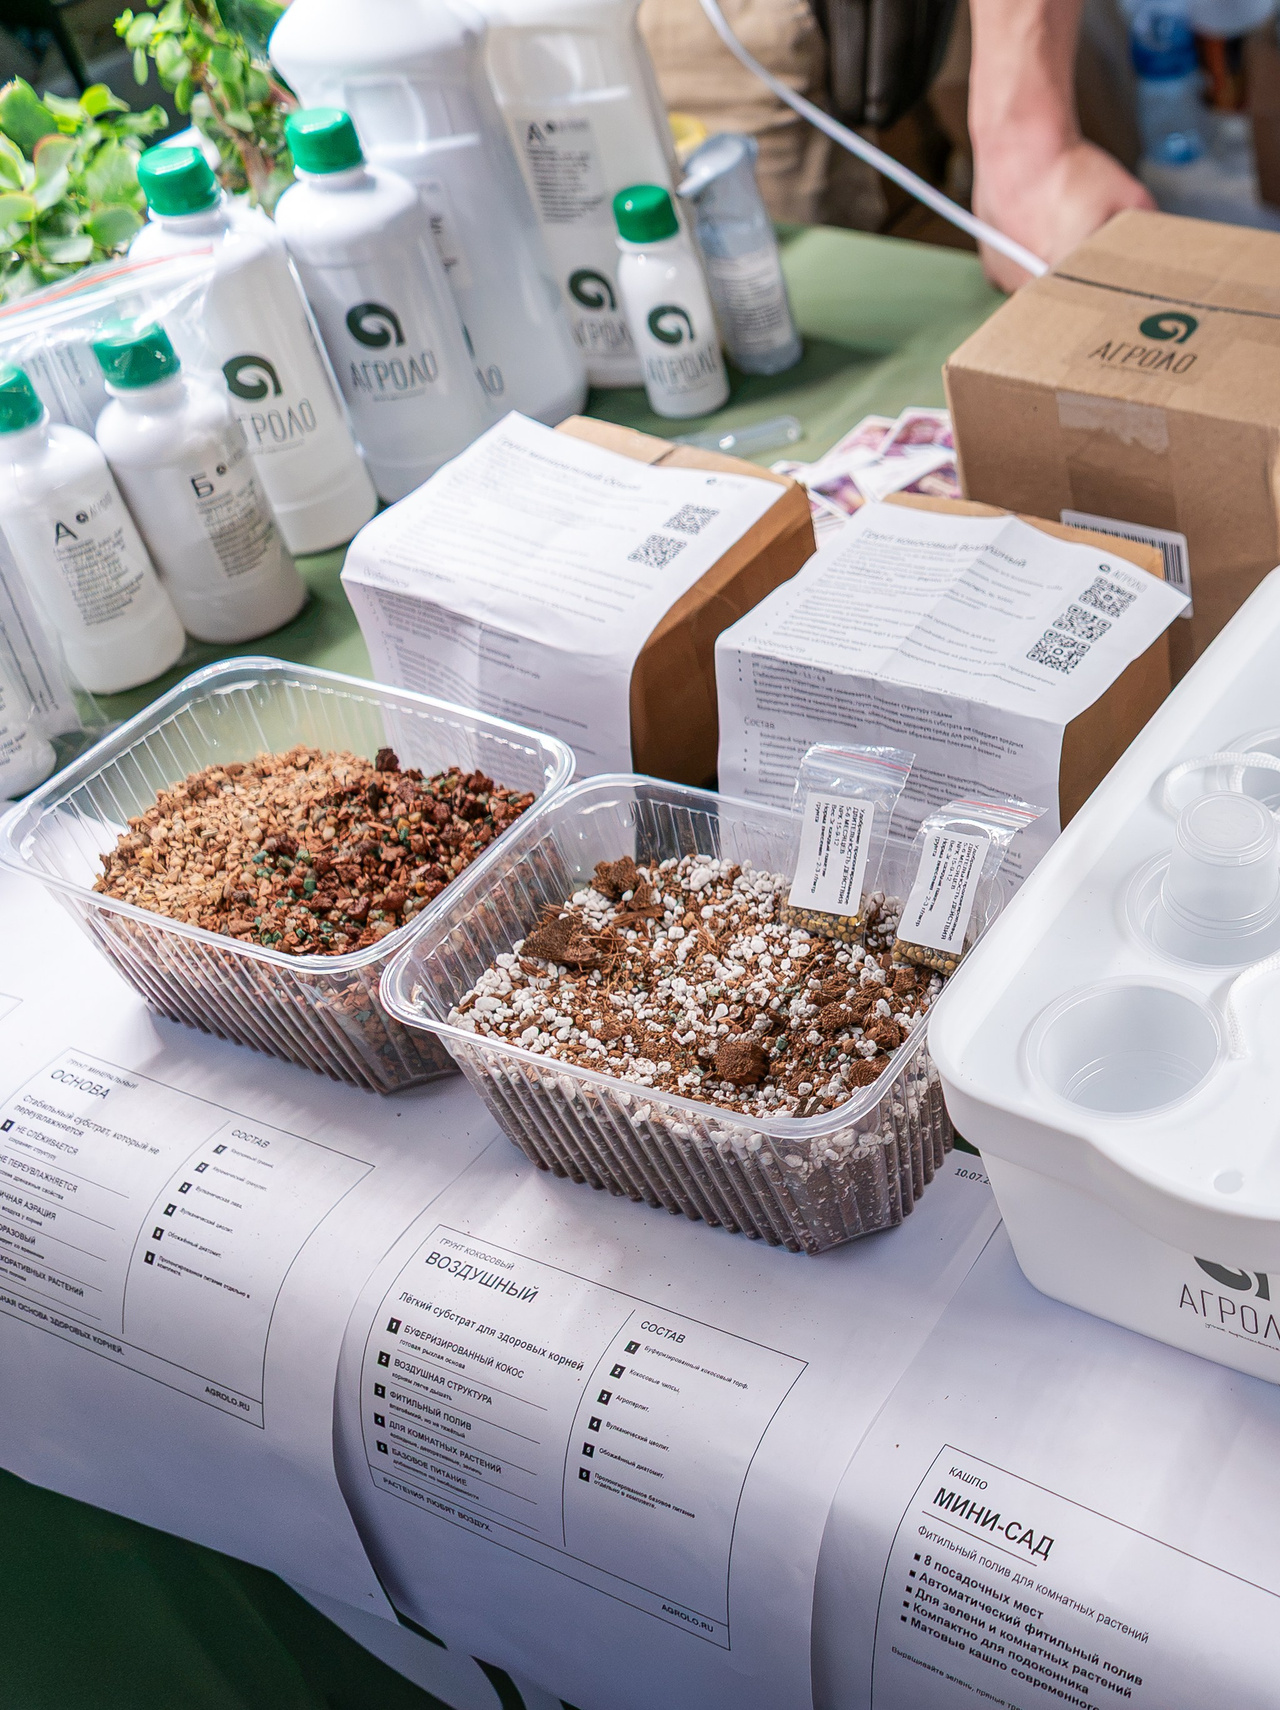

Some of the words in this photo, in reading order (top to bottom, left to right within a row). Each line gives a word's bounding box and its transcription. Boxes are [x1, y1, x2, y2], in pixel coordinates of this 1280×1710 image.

[350, 350, 439, 392] АГРОЛО
[1088, 341, 1198, 374] АГРОЛО
[237, 399, 317, 442] ГРОЛО
[190, 472, 214, 499] Б
[55, 520, 78, 546] А
[51, 1069, 111, 1099] ОСНОВА
[14, 1104, 85, 1138] переувлажняется
[23, 1094, 75, 1121] Стабильный
[73, 1115, 111, 1138] субстрат,
[112, 1131, 149, 1151] который
[149, 1146, 160, 1155] не
[16, 1125, 25, 1135] НЕ
[26, 1128, 79, 1156] СЛЁЖИВАЕТСЯ
[231, 1129, 271, 1149] СОСТАВ
[8, 1158, 78, 1193] ПЕРЕУВЛАЖНЯЕТСЯ
[954, 1168, 992, 1186] 10.07.2
[23, 1199, 57, 1221] АЭРАЦИЯ
[439, 1237, 465, 1253] ГРУНТ
[464, 1246, 515, 1271] КОКОСОВЫЙ
[48, 1274, 84, 1297] РАСТЕНИЙ
[425, 1251, 539, 1304] ВОЗДУШНЫЙ
[18, 1302, 49, 1321] ОСНОВА
[50, 1316, 92, 1340] ЗДОРОВЫХ
[399, 1291, 433, 1312] Лёгкий
[433, 1306, 477, 1329] субстрат
[476, 1324, 497, 1338] для
[497, 1331, 548, 1357] здоровых
[548, 1351, 585, 1372] корней
[640, 1320, 686, 1344] СОСТАВ
[399, 1339, 422, 1352] готовая
[422, 1348, 445, 1361] рыхлая
[445, 1357, 466, 1370] основа
[404, 1325, 494, 1368] БУФЕРИЗИРОВАННЫЙ
[495, 1361, 525, 1379] КОКОС
[644, 1345, 700, 1371] Буферизированный
[700, 1366, 733, 1383] кокосовый
[732, 1378, 749, 1390] торф.
[394, 1358, 446, 1386] ВОЗДУШНАЯ
[447, 1380, 493, 1405] СТРУКТУРА
[629, 1369, 660, 1386] Кокосовые
[205, 1386, 250, 1412] AGROLO.RU
[390, 1391, 442, 1418] ФИТИЛЬНЫЙ
[443, 1412, 472, 1431] ПОЛИВ
[616, 1394, 650, 1413] Агроперлит.
[389, 1421, 406, 1432] ДЛЯ
[407, 1427, 458, 1455] КОМНАТНЫХ
[459, 1450, 502, 1474] РАСТЕНИЙ
[605, 1421, 648, 1443] Вулканический
[648, 1439, 670, 1452] цеолит.
[392, 1448, 428, 1470] БАЗОВОЕ
[430, 1465, 468, 1486] ПИТАНИЕ
[599, 1447, 636, 1467] Обожжённый
[636, 1462, 665, 1479] диатомит.
[948, 1465, 988, 1491] КАШПО
[383, 1477, 425, 1501] РАСТЕНИЯ
[457, 1512, 493, 1533] ВОЗДУХ.
[932, 1487, 1055, 1561] МИНИ-САД
[918, 1524, 978, 1562] Фитильный
[978, 1555, 1012, 1578] полив
[1012, 1571, 1034, 1588] для
[1036, 1582, 1095, 1618] комнатных
[1095, 1611, 1151, 1645] растений
[924, 1555, 933, 1566] 8
[934, 1560, 1011, 1605] посадочных
[1012, 1599, 1044, 1620] мест
[661, 1604, 714, 1633] AGROLO.RU
[919, 1573, 1022, 1627] Автоматический
[1024, 1622, 1100, 1666] фитильный
[1102, 1659, 1143, 1687] полив
[911, 1618, 965, 1651] Матовые
[968, 1646, 1008, 1671] кашпо
[913, 1602, 978, 1641] Компактно
[979, 1636, 1005, 1654] для
[1007, 1649, 1090, 1695] подоконника
[914, 1587, 940, 1607] Для
[942, 1600, 986, 1630] зелени
[988, 1622, 997, 1633] и
[1000, 1628, 1070, 1669] комнатных
[1072, 1662, 1132, 1699] растений
[891, 1645, 945, 1677] Выращивайте
